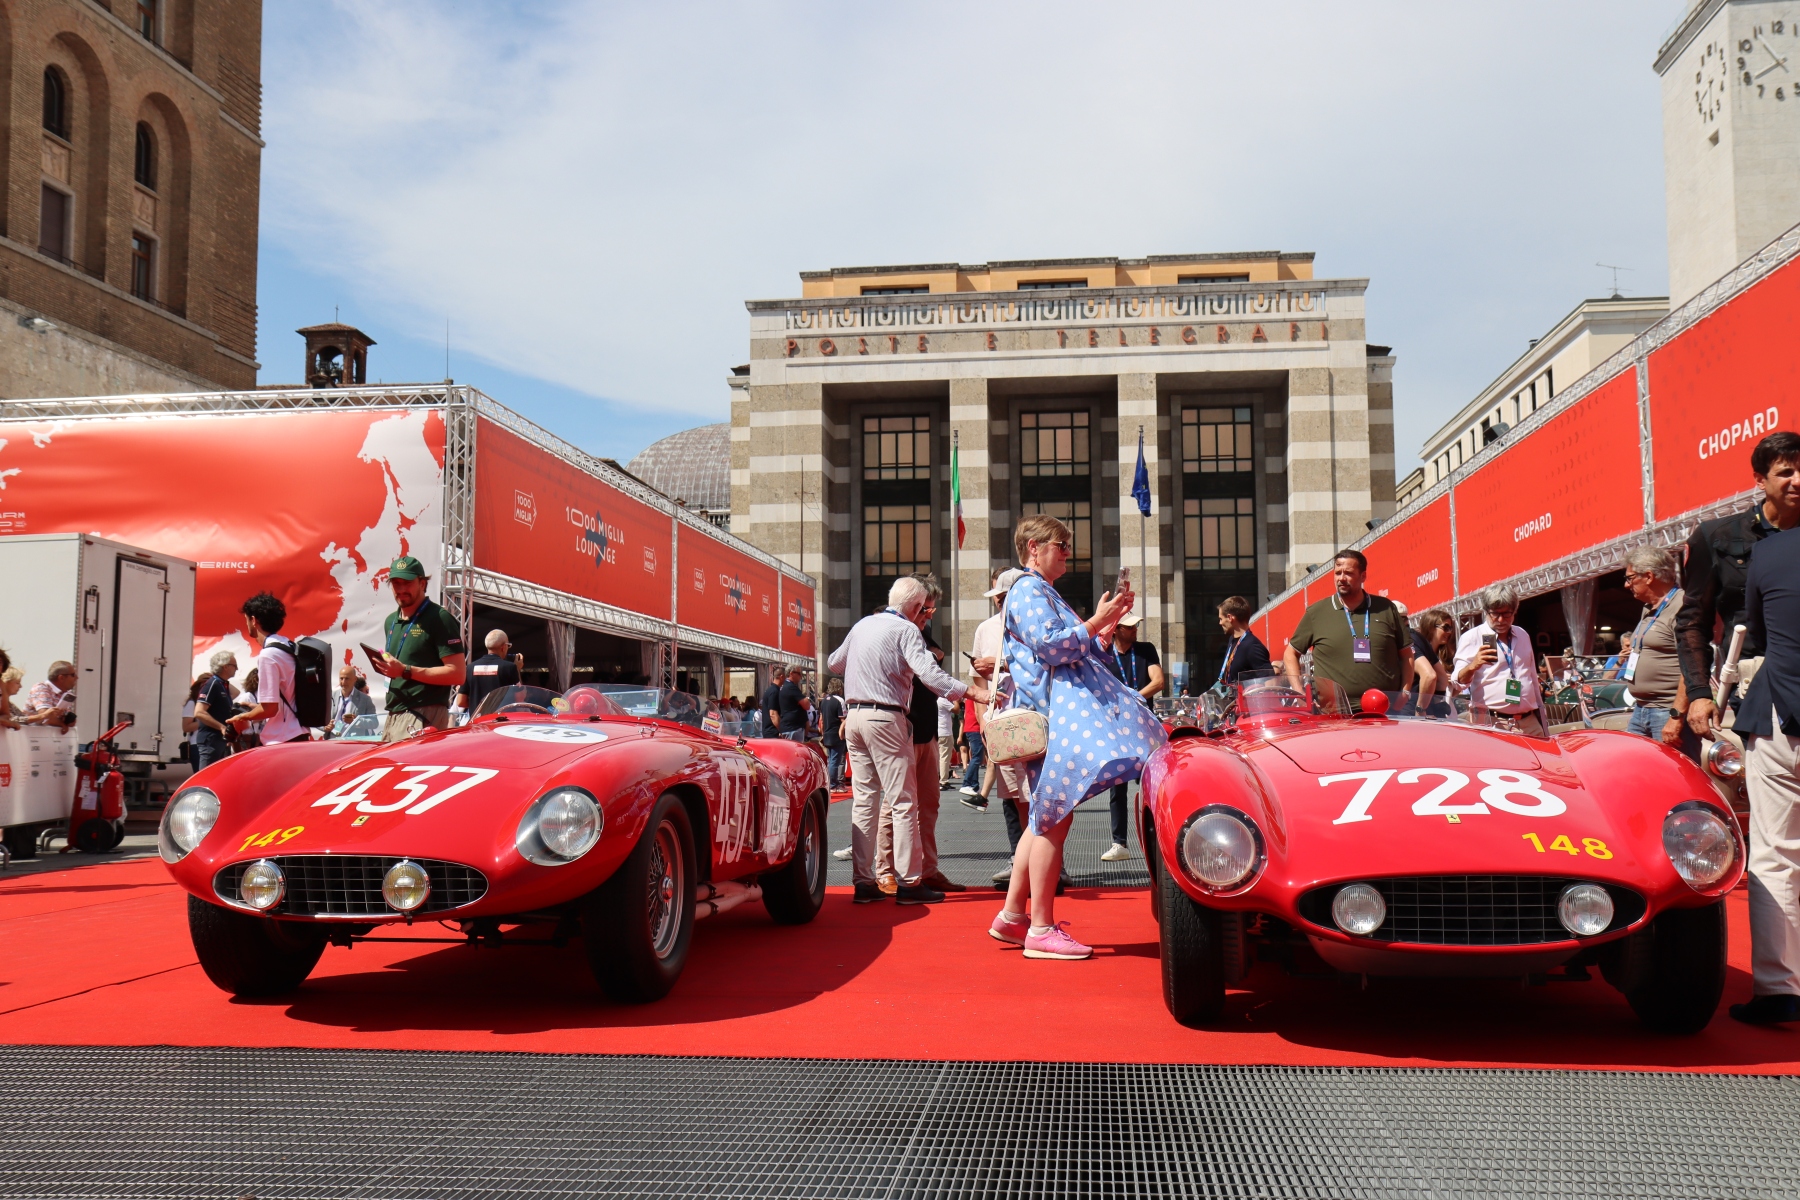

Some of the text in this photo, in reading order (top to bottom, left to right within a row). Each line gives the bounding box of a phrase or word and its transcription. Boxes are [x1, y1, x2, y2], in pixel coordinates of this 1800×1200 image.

[1771, 20, 1784, 33] 12
[1738, 39, 1753, 52] 10
[1737, 57, 1745, 70] 9
[1757, 84, 1765, 97] 7
[1775, 87, 1785, 100] 6
[787, 322, 1325, 355] POSTE E TELEGRAFI
[1698, 406, 1779, 460] CHOPARD
[517, 495, 531, 508] 1000
[515, 508, 532, 523] MIGLIA
[566, 506, 625, 545] 1000 MIGLIA
[1514, 512, 1552, 542] CHOPARD
[575, 535, 616, 565] LOUNGE
[719, 573, 752, 596] 1000 MIGLIA
[1416, 568, 1438, 588] CHOPARD
[724, 593, 747, 612] LOUNGE
[515, 726, 587, 738] 149
[311, 765, 499, 816] 437
[1317, 767, 1567, 825] 728
[238, 826, 305, 852] 149
[1521, 832, 1614, 860] 148
